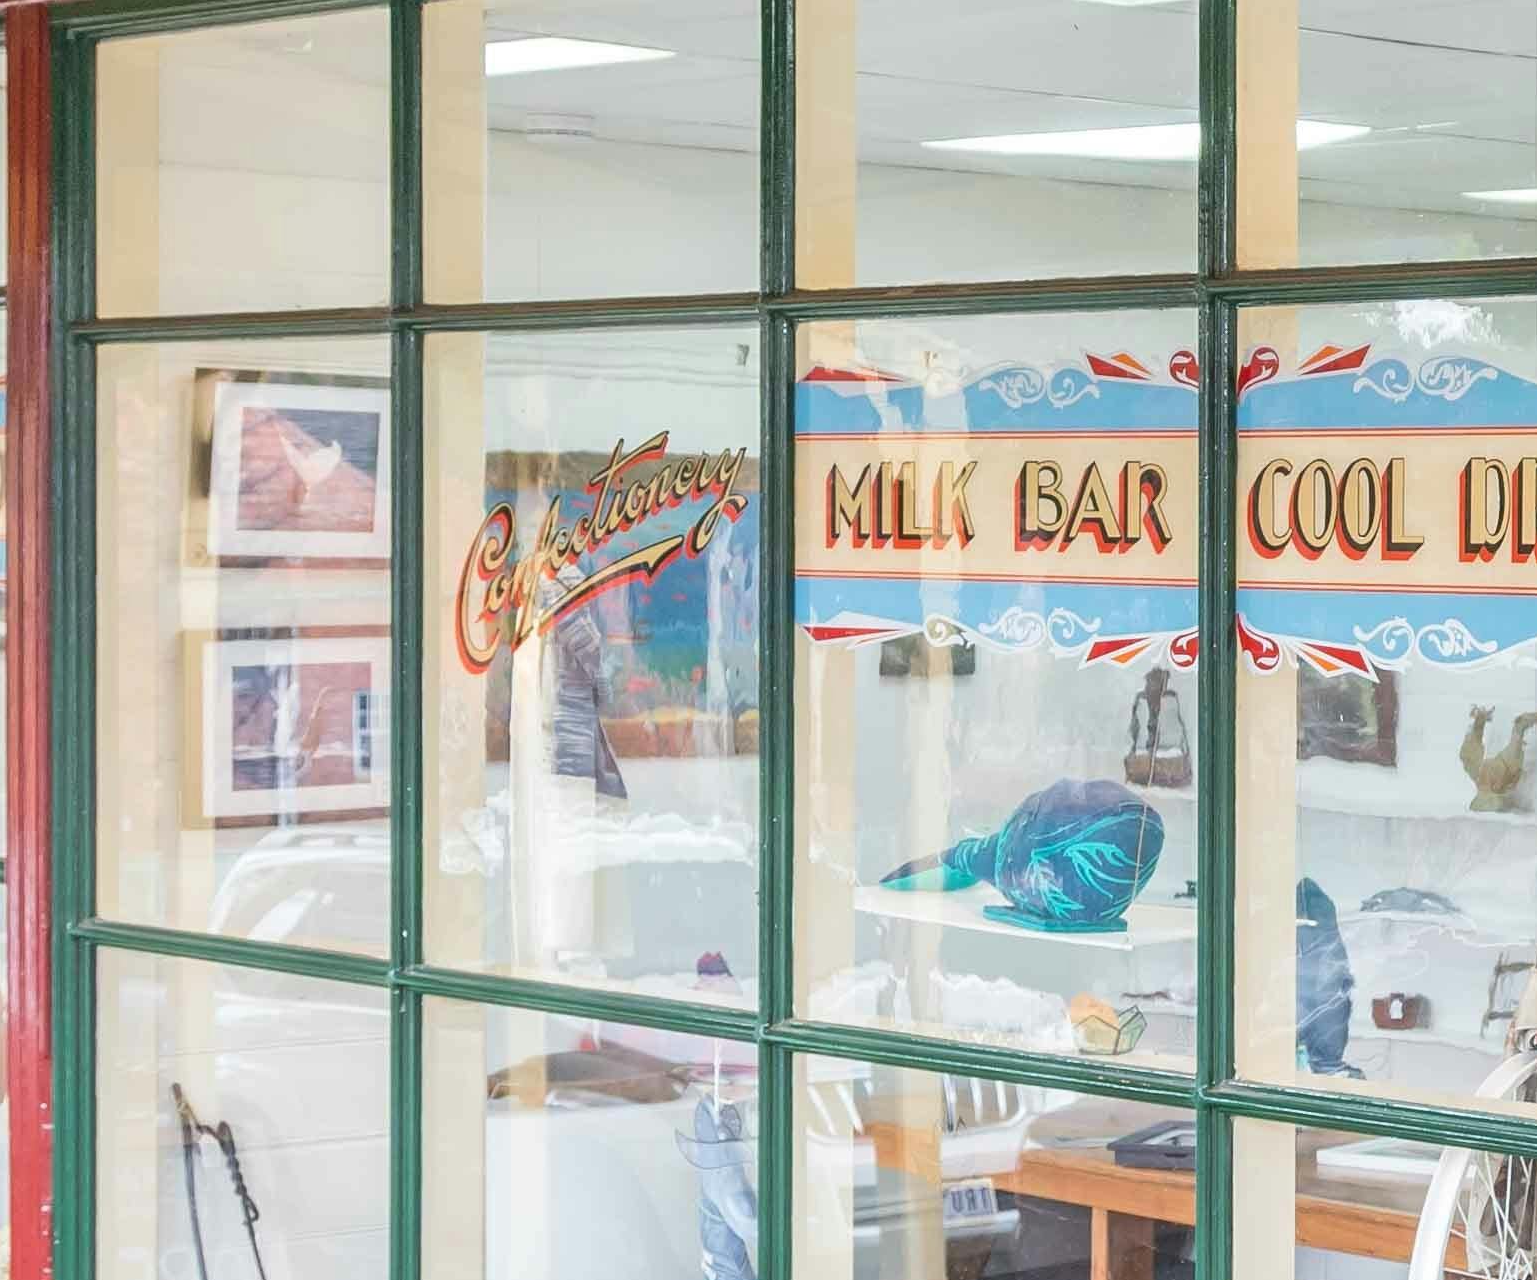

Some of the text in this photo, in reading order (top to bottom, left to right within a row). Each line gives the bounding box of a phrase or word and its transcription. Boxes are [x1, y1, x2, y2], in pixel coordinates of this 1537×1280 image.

[455, 430, 748, 674] Confectionery
[825, 457, 1173, 554] MILK BAR
[1247, 457, 1425, 563] COOL
